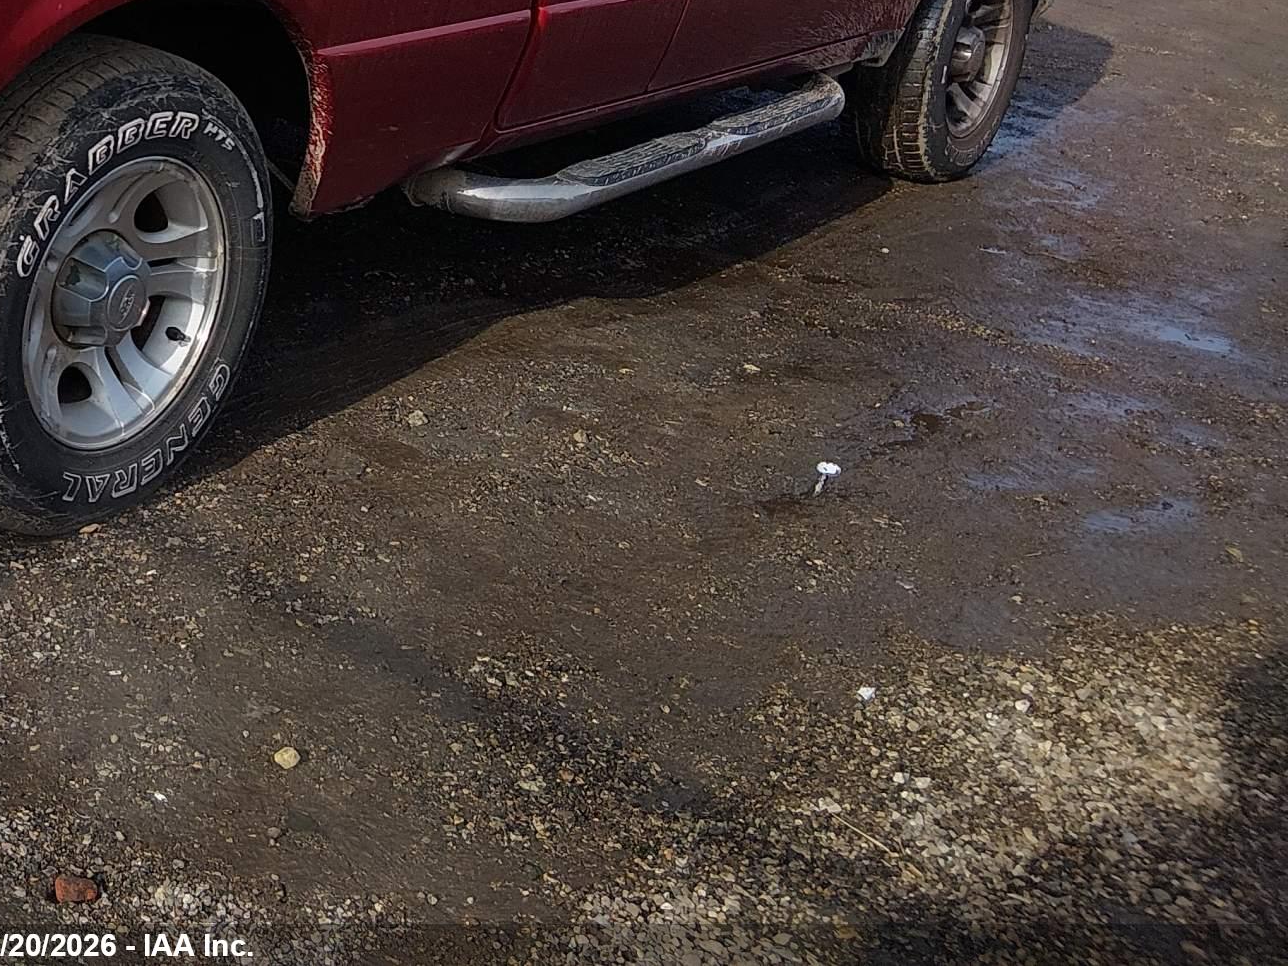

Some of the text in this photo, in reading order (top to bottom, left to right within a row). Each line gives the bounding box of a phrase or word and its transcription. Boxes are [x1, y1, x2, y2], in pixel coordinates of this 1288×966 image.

[17, 111, 236, 277] GRABBER HTS
[62, 363, 231, 503] GENERAL
